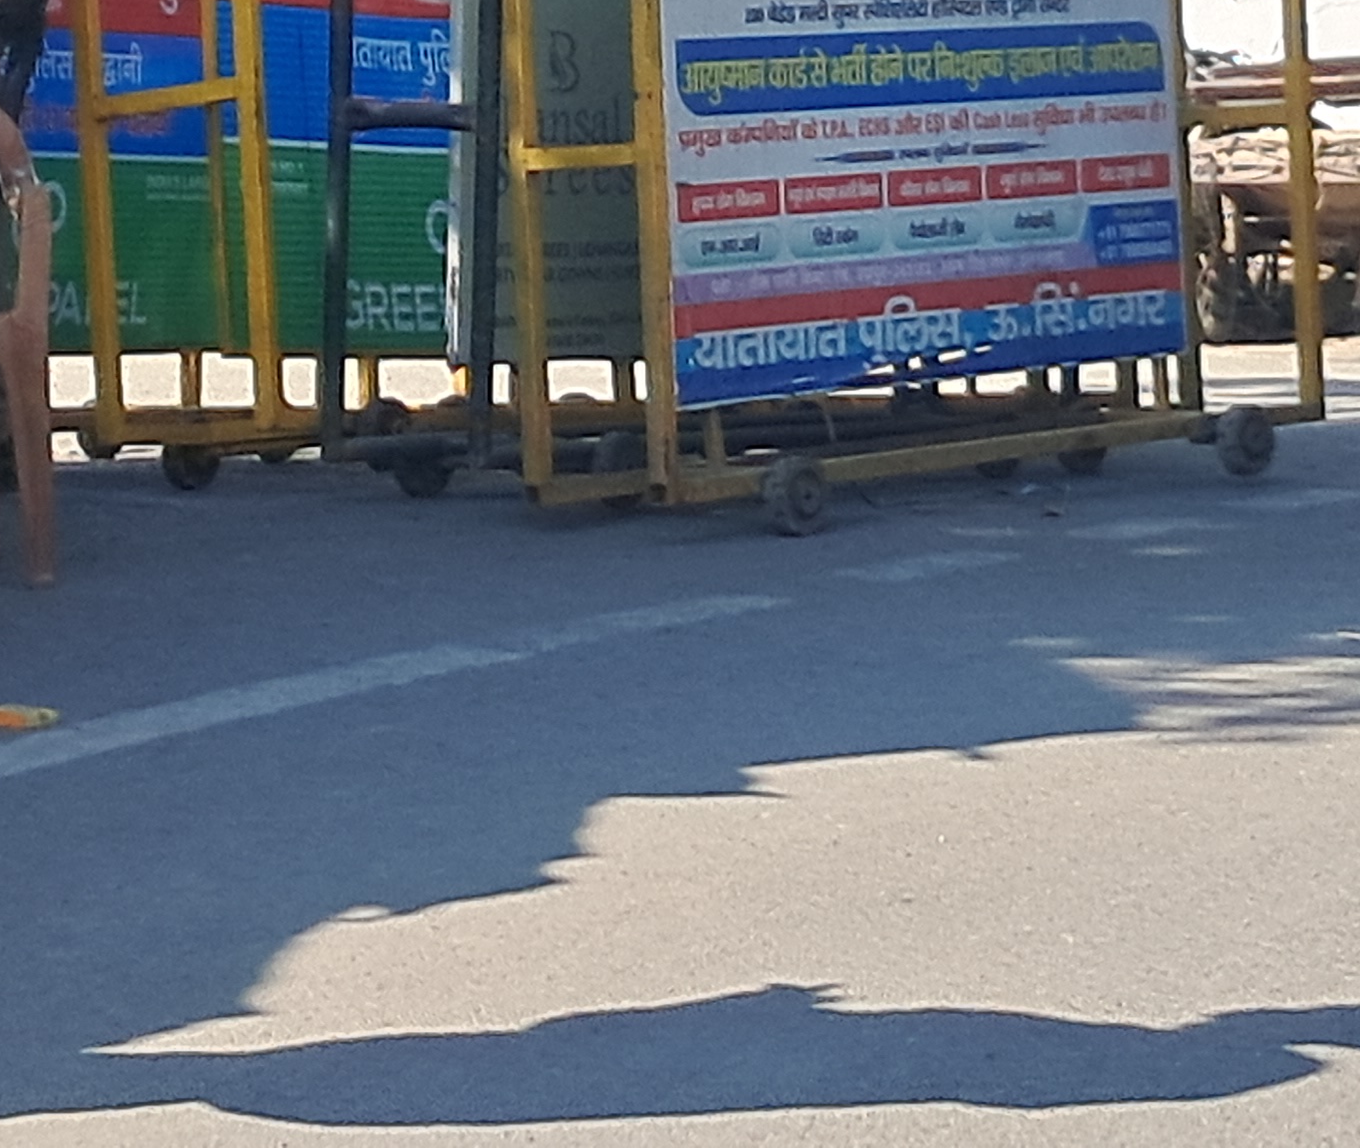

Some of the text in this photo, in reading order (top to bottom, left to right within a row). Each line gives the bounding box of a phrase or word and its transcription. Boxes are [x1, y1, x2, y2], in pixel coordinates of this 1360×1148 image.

[681, 59, 766, 104] आयुष्मान
[769, 46, 808, 89] कार्ड
[811, 46, 828, 88] से
[830, 42, 868, 86] भर्ती
[870, 43, 905, 86] होने
[907, 52, 932, 82] पर
[894, 112, 922, 136] और
[948, 107, 969, 130] की
[346, 278, 446, 332] GREE
[693, 318, 849, 369] यातायात
